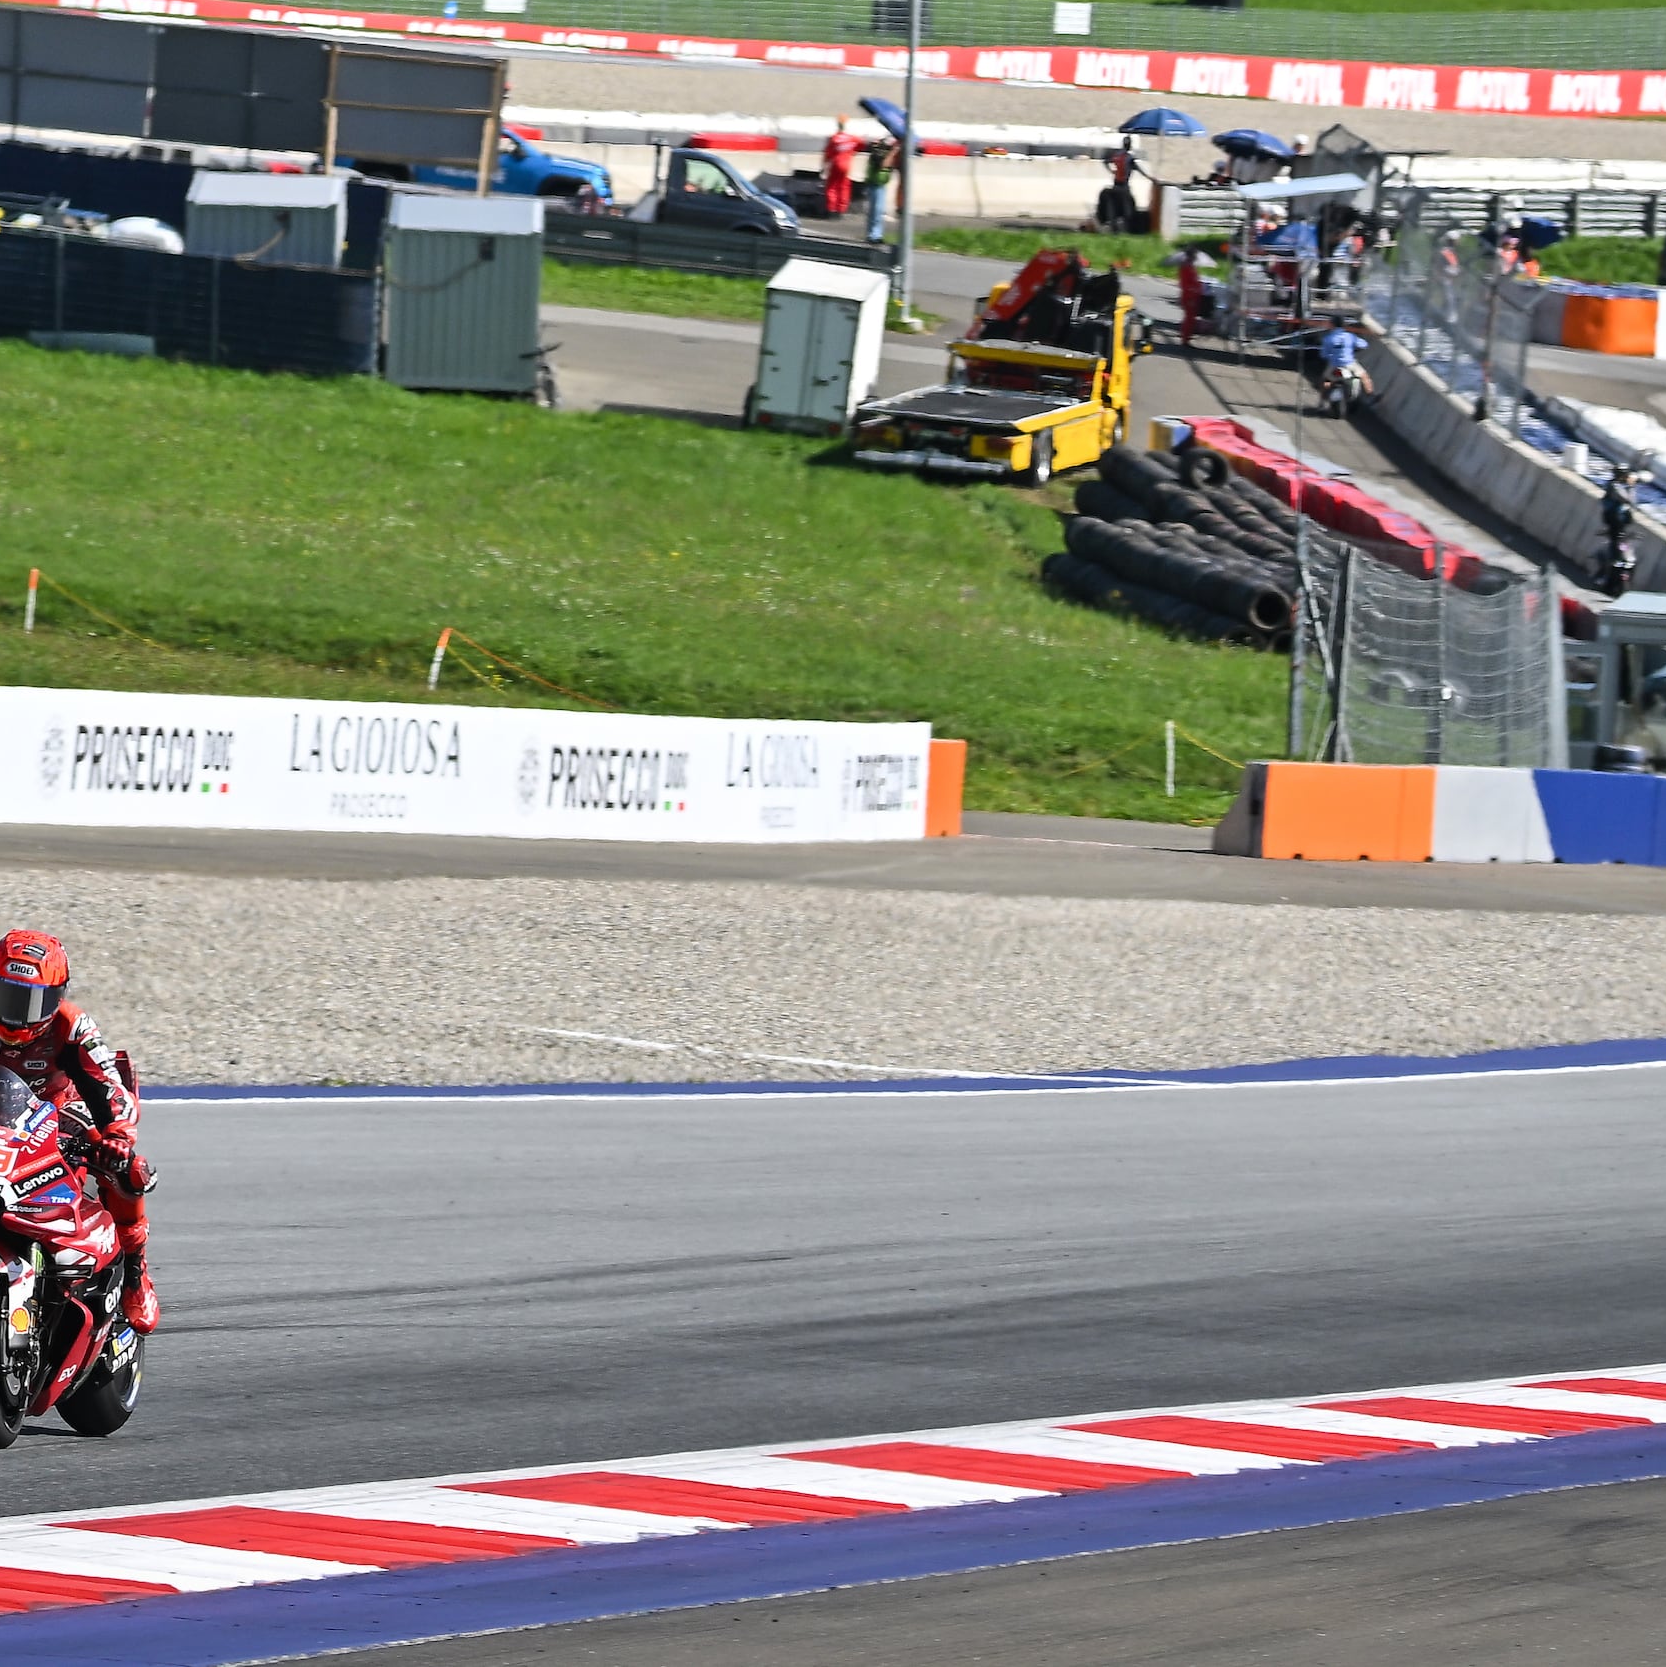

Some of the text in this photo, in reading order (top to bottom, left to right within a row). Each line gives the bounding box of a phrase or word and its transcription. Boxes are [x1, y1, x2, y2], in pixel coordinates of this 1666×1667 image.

[1267, 62, 1344, 106] MOTUL
[1363, 66, 1439, 110] MOTUL
[1455, 70, 1531, 111] MOTUL
[1549, 73, 1623, 113] MOTUL
[71, 724, 196, 795] PROSECCO
[545, 744, 661, 812] PROSECCO
[9, 963, 34, 975] SHOEI
[32, 1119, 59, 1148] riello
[14, 1166, 64, 1195] Lenovo
[50, 1195, 72, 1204] TIM
